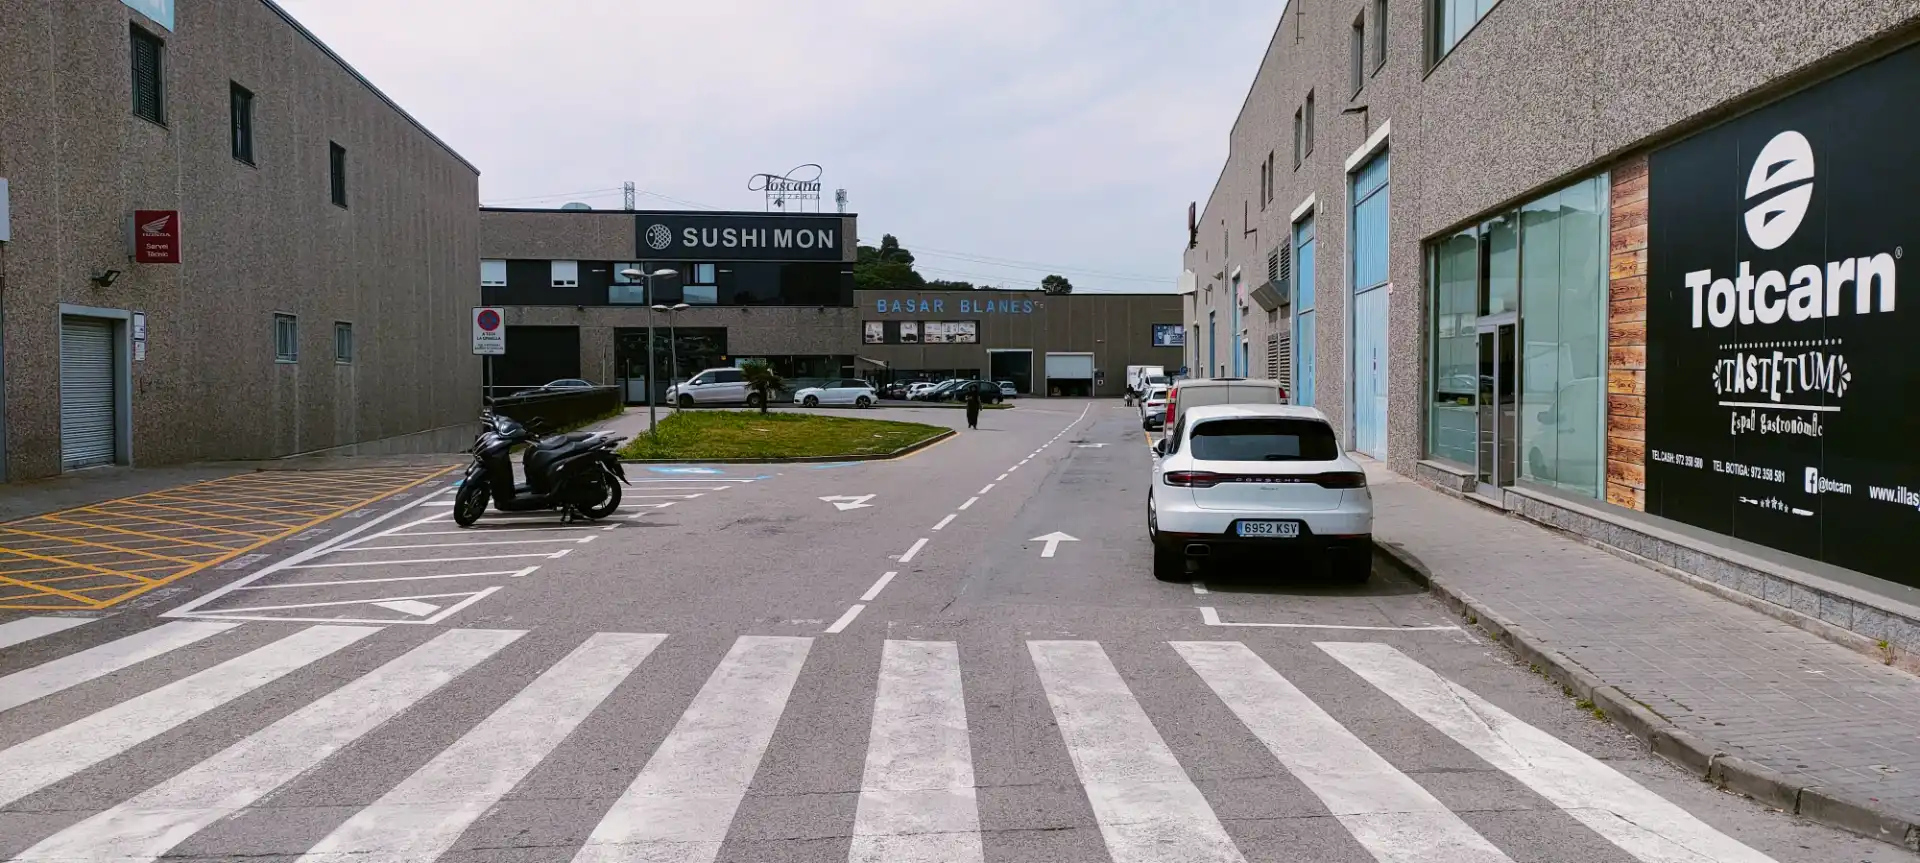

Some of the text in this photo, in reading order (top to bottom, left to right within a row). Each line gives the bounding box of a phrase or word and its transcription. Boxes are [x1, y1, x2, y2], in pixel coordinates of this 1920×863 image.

[748, 168, 822, 191] Toscana
[683, 227, 833, 248] SUSHI MON
[1685, 252, 1895, 328] Totcarn
[877, 299, 1033, 314] BASAR BLANES
[1723, 350, 1836, 402] TASTETUM
[1731, 408, 1823, 437] Espai gastronòmic
[1675, 453, 1685, 466] 972
[1713, 460, 1785, 484] TEL. BOTIGA: 972 358 581
[1818, 476, 1852, 494] @totcarn
[1868, 485, 1920, 511] www.illas
[1244, 523, 1298, 534] 6952 KSV
